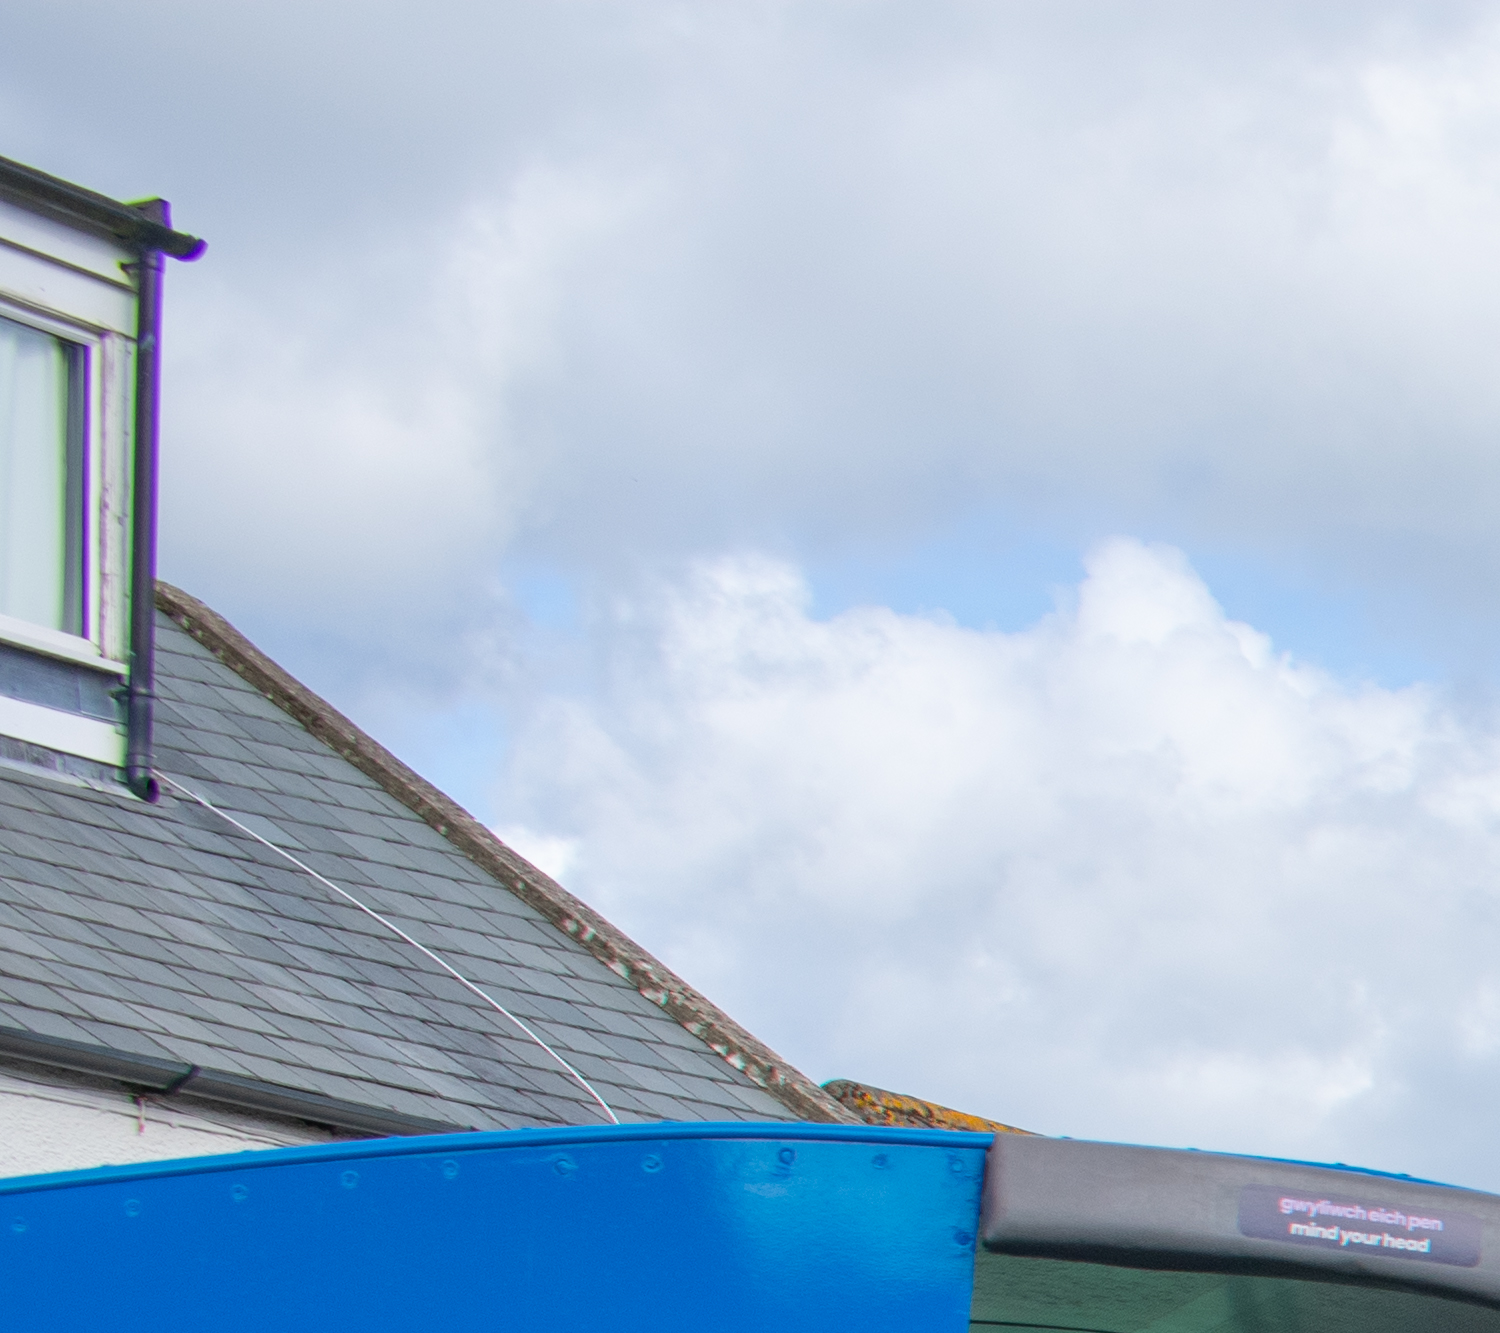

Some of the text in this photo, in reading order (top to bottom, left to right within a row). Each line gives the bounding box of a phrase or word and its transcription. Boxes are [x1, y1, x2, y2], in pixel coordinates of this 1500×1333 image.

[1368, 1208, 1407, 1226] eich
[1407, 1216, 1444, 1231] pen
[1288, 1221, 1431, 1253] mind your head
